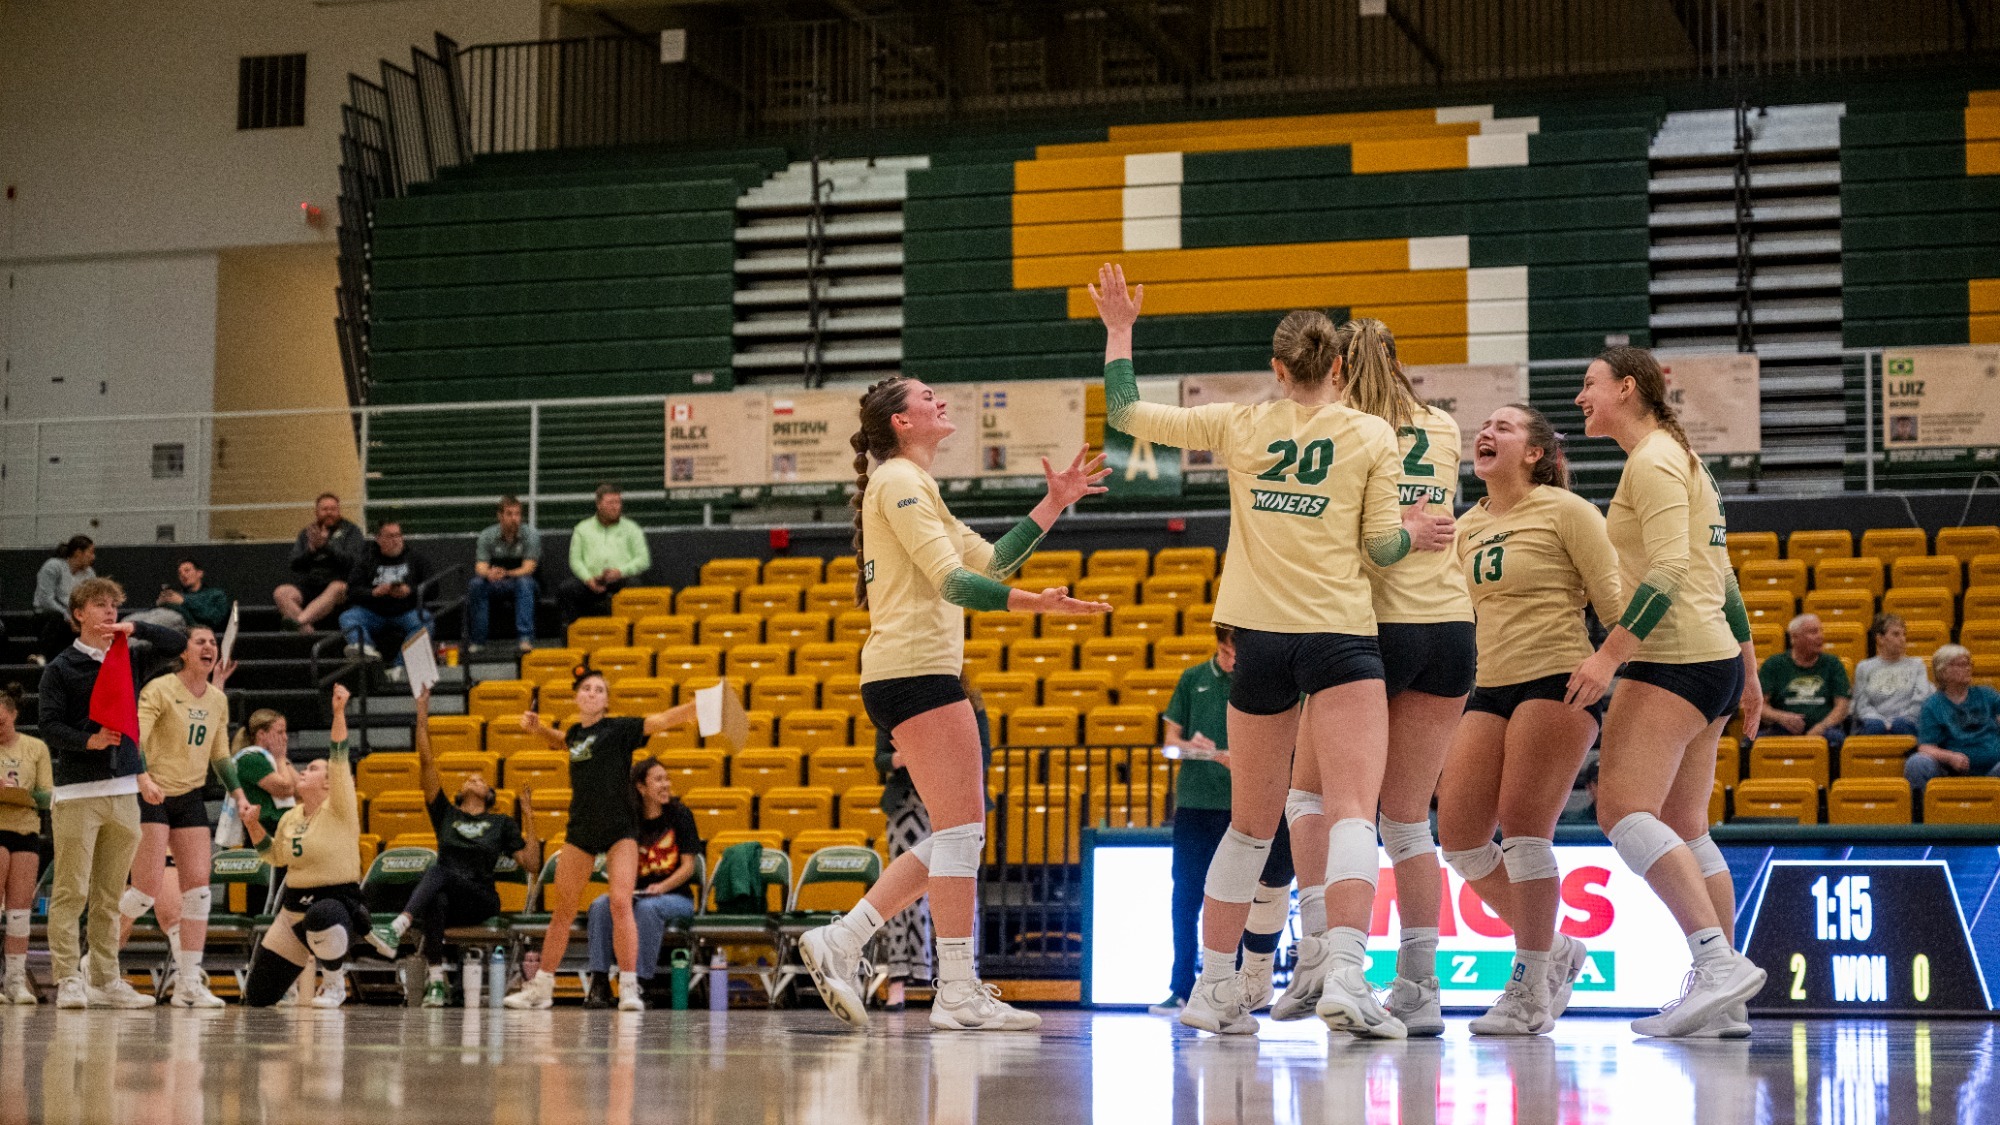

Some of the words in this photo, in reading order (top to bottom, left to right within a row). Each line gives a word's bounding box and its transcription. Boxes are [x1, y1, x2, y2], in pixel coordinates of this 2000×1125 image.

[1889, 381, 1925, 396] LUIZ
[670, 426, 708, 440] ALEX
[1257, 437, 1335, 486] 20
[1398, 426, 1435, 476] 2
[1255, 489, 1326, 515] MINERS
[1398, 485, 1444, 502] NERS
[1473, 546, 1504, 585] 13
[187, 723, 207, 746] 18
[292, 837, 303, 857] 5
[1811, 875, 1873, 941] 1:15
[1790, 952, 1806, 1000] 2
[1832, 954, 1888, 1002] WON
[1912, 953, 1930, 1001] 0
